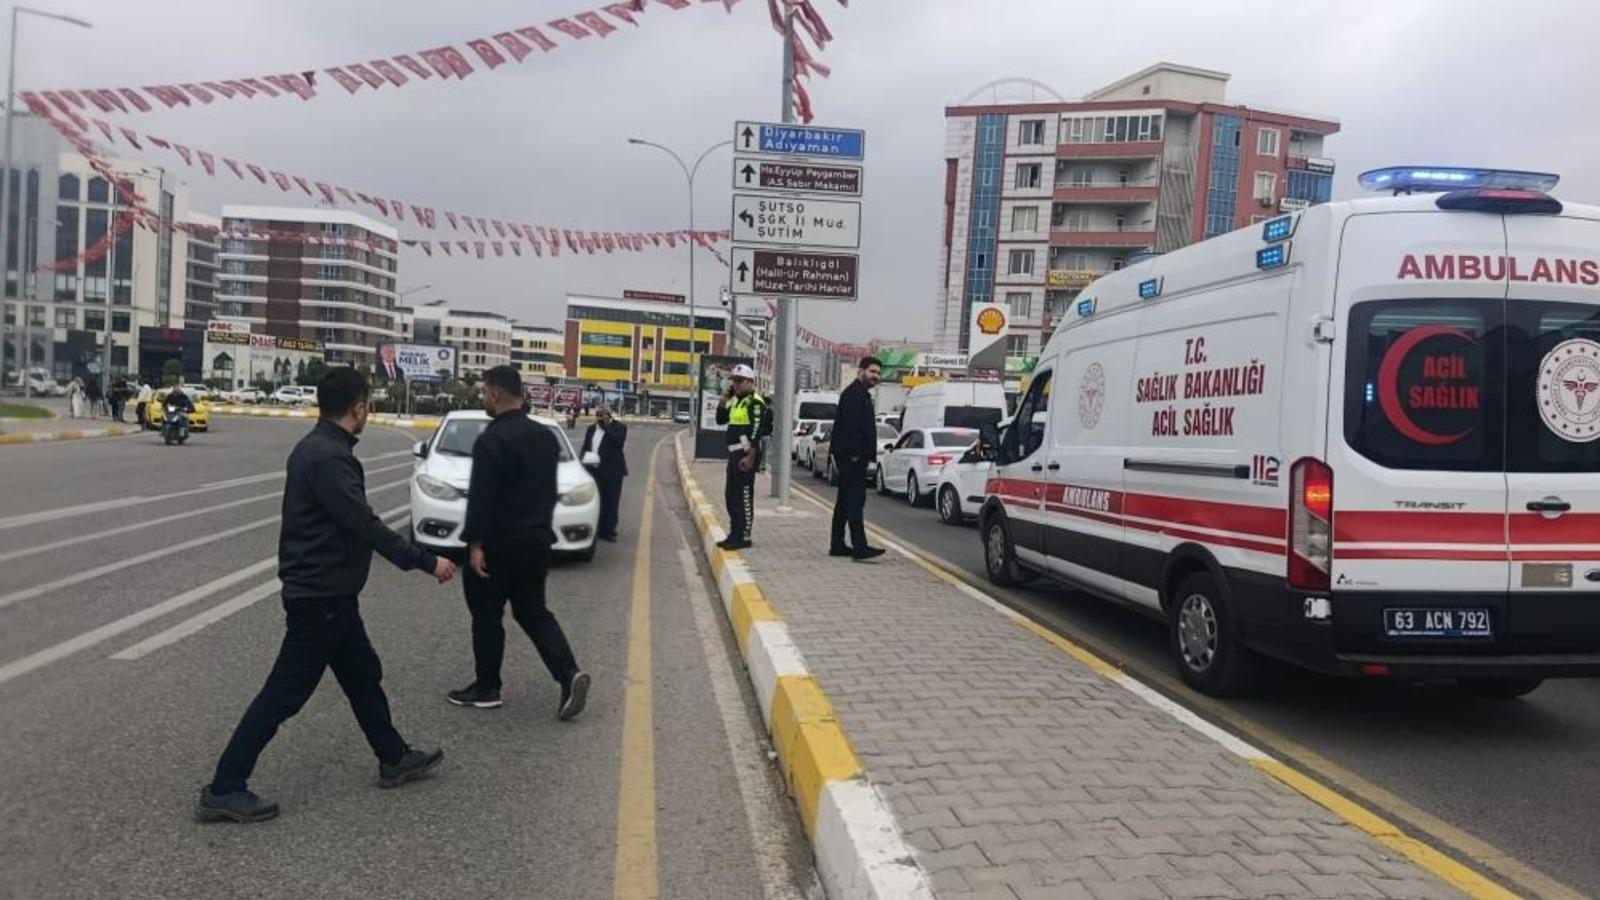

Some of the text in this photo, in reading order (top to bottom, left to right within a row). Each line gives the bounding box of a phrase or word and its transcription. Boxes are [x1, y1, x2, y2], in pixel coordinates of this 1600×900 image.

[764, 138, 839, 153] Adıyaman
[805, 168, 857, 180] Peygamber
[758, 214, 786, 225] SGK
[1397, 254, 1600, 286] AMBULANS
[1185, 336, 1207, 365] T.C.
[1423, 353, 1467, 379] ACİL
[1136, 359, 1265, 403] SAĞLIK BAKANLIĞI
[1410, 382, 1479, 409] SAĞLIK
[1152, 402, 1235, 437] ACİL SAĞLIK
[1253, 454, 1280, 481] 112
[1062, 486, 1110, 511] AMBULANS
[1394, 500, 1468, 509] TRANSIT
[1394, 611, 1487, 630] 63 ACN 792
